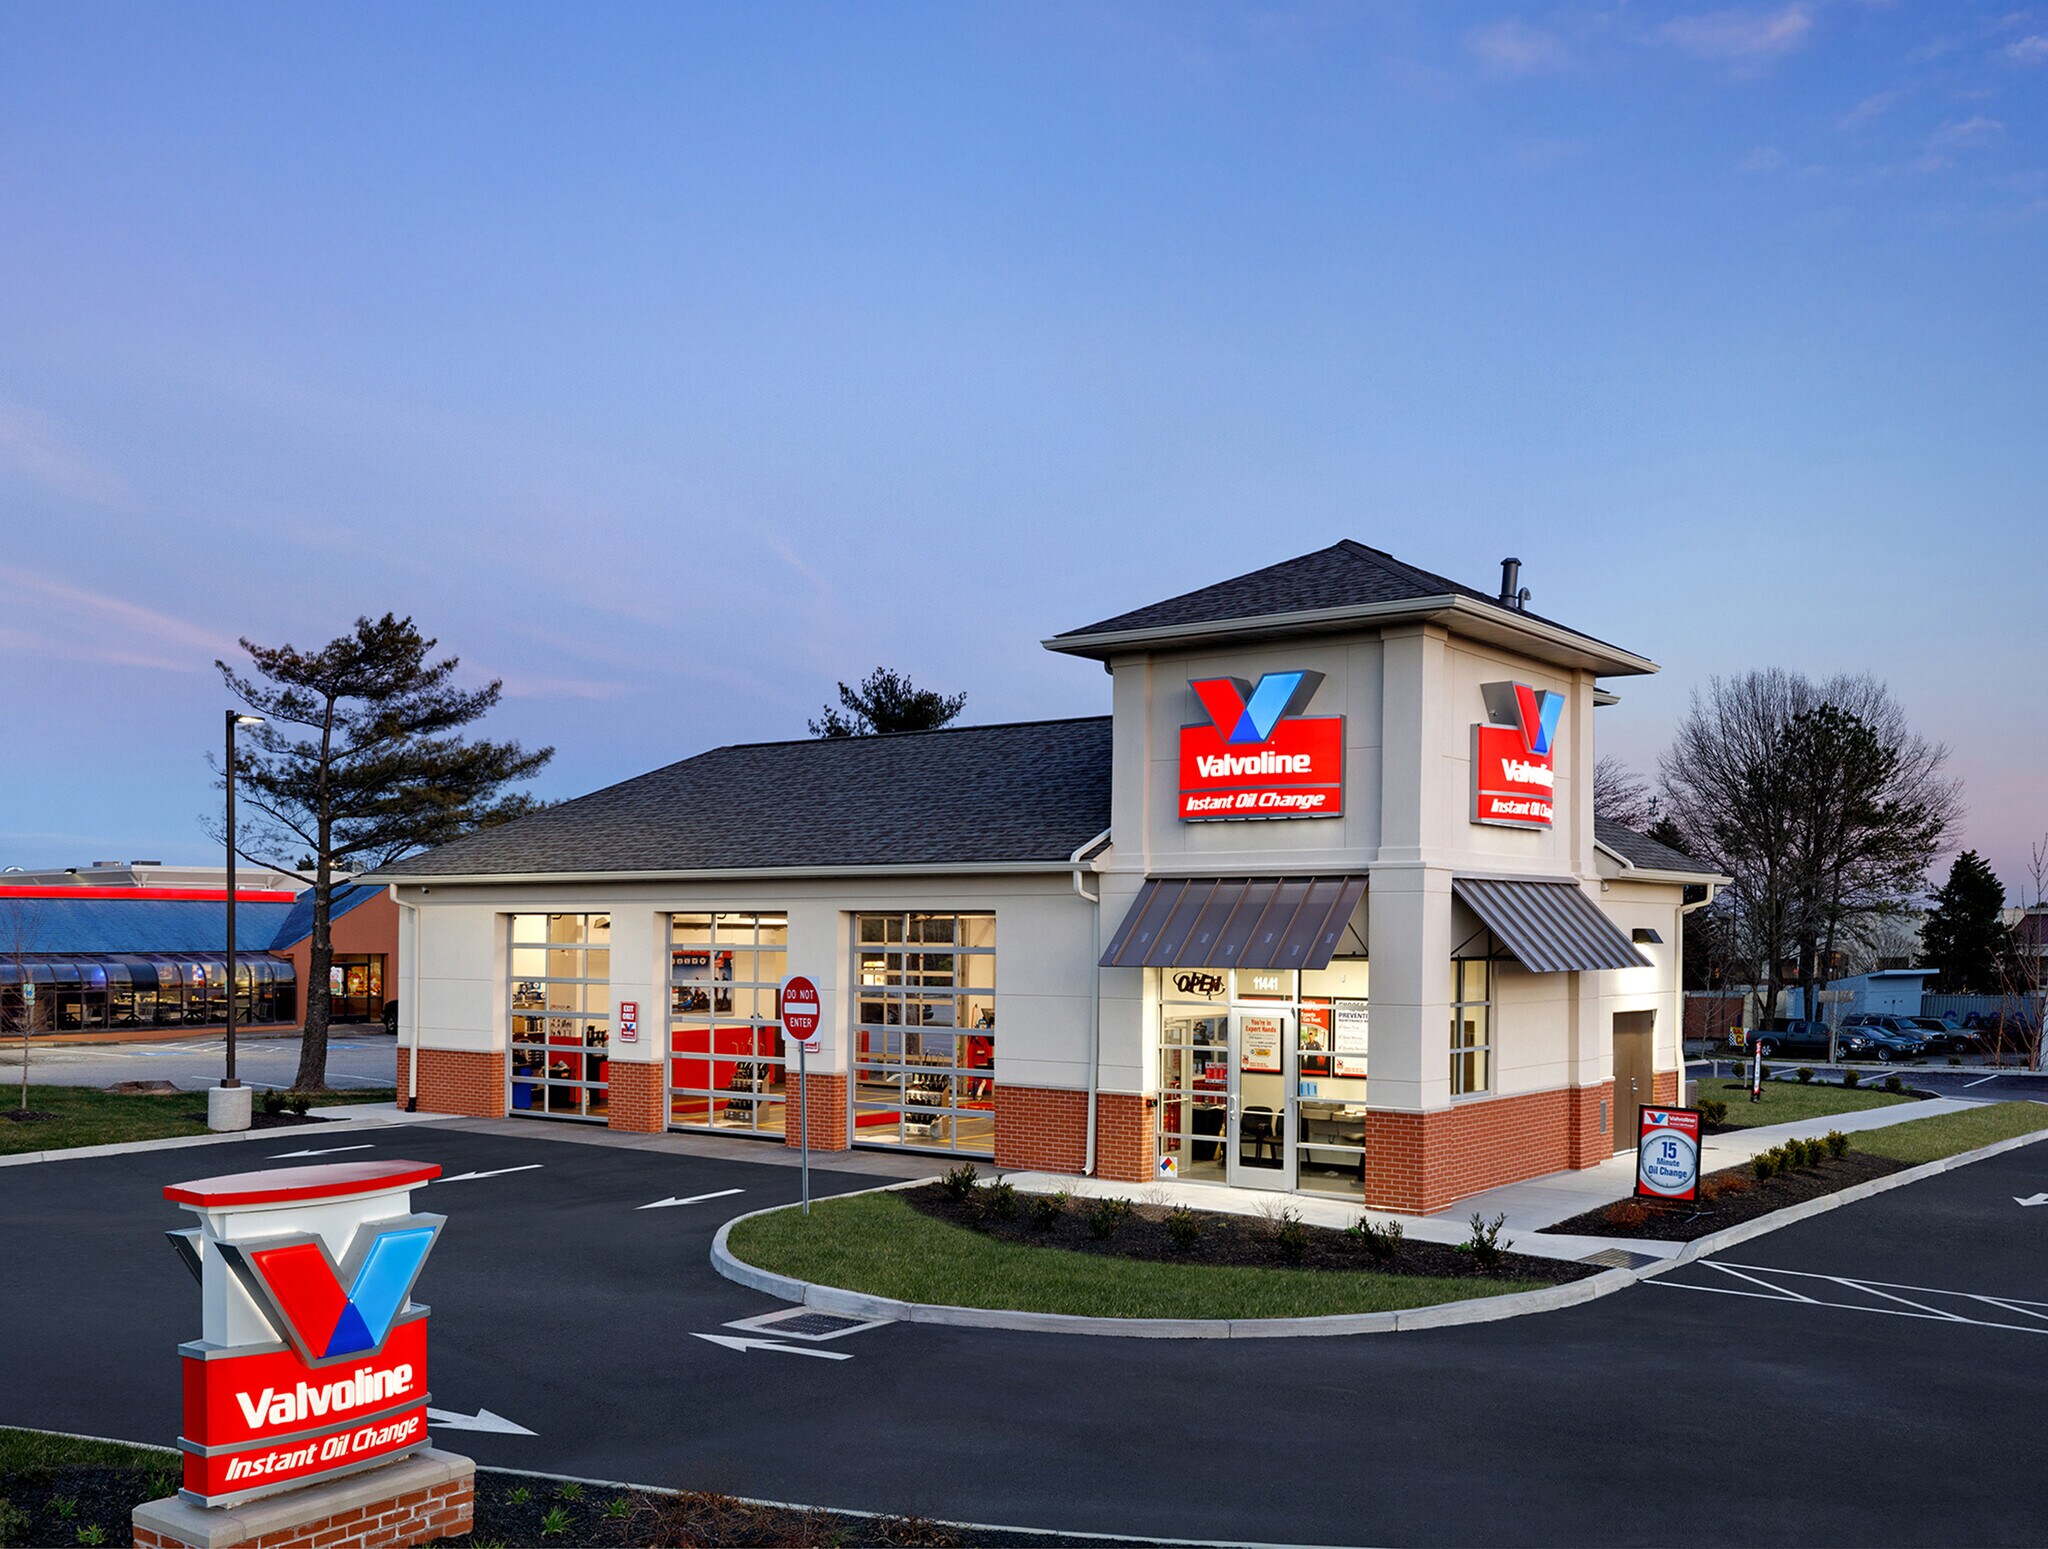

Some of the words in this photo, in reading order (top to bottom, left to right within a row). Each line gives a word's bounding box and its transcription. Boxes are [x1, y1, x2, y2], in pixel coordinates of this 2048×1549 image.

[1196, 751, 1311, 778] Valvoline
[1186, 794, 1234, 811] Instant
[1235, 792, 1256, 808] Oil
[1258, 792, 1326, 809] Change
[1490, 798, 1530, 815] Instant
[1177, 972, 1222, 993] OPEN
[1253, 976, 1279, 991] 11441
[786, 989, 796, 999] DO
[799, 989, 814, 1000] NOT
[789, 1017, 812, 1028] ENTER
[1661, 1141, 1677, 1159] 15
[1656, 1157, 1680, 1167] Minute
[1648, 1165, 1659, 1175] Oil
[1659, 1166, 1688, 1180] Change
[235, 1363, 414, 1429] Valvoline
[225, 1443, 318, 1481] Instant
[320, 1433, 350, 1461] Oil
[351, 1416, 420, 1452] Change
